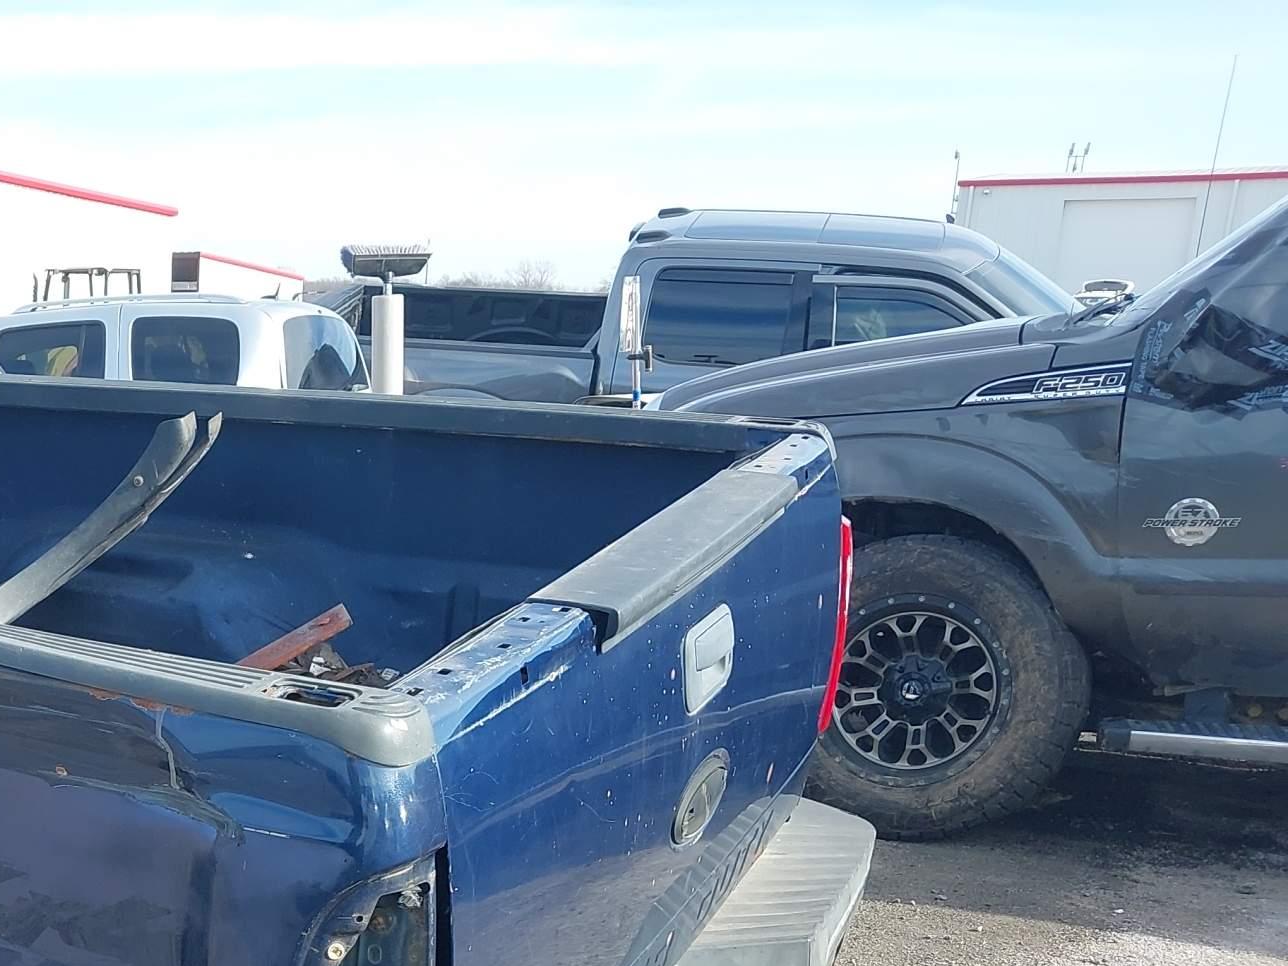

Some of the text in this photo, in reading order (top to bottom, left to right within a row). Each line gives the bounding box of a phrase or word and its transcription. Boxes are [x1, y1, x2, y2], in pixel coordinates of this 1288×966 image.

[1032, 372, 1126, 393] F-250
[1142, 517, 1242, 528] POWER STROKE
